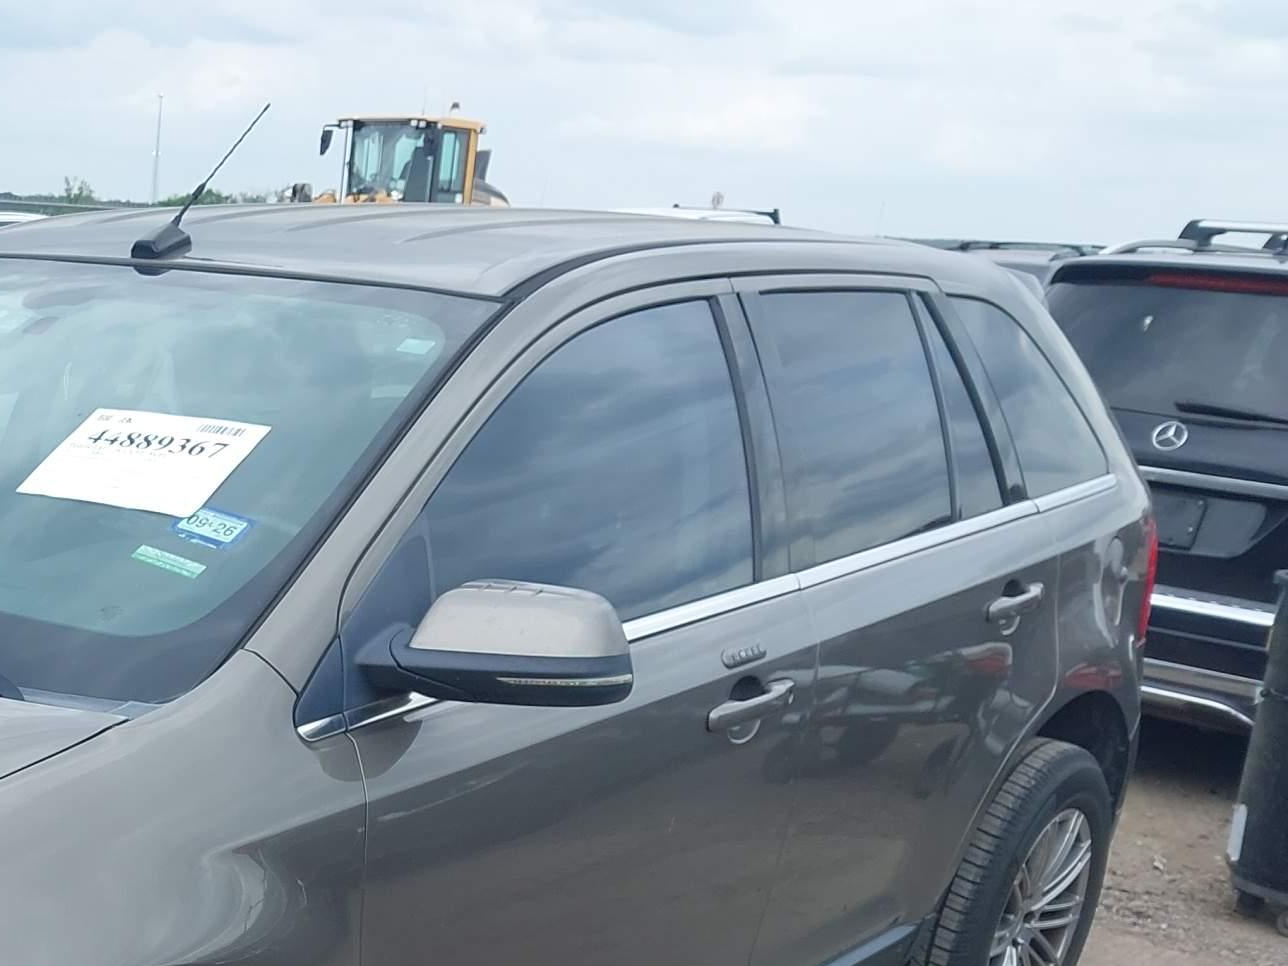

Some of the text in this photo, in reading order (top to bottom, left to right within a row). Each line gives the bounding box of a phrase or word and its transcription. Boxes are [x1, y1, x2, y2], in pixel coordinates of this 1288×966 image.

[87, 428, 230, 459] 44889367
[187, 514, 238, 537] 09 26
